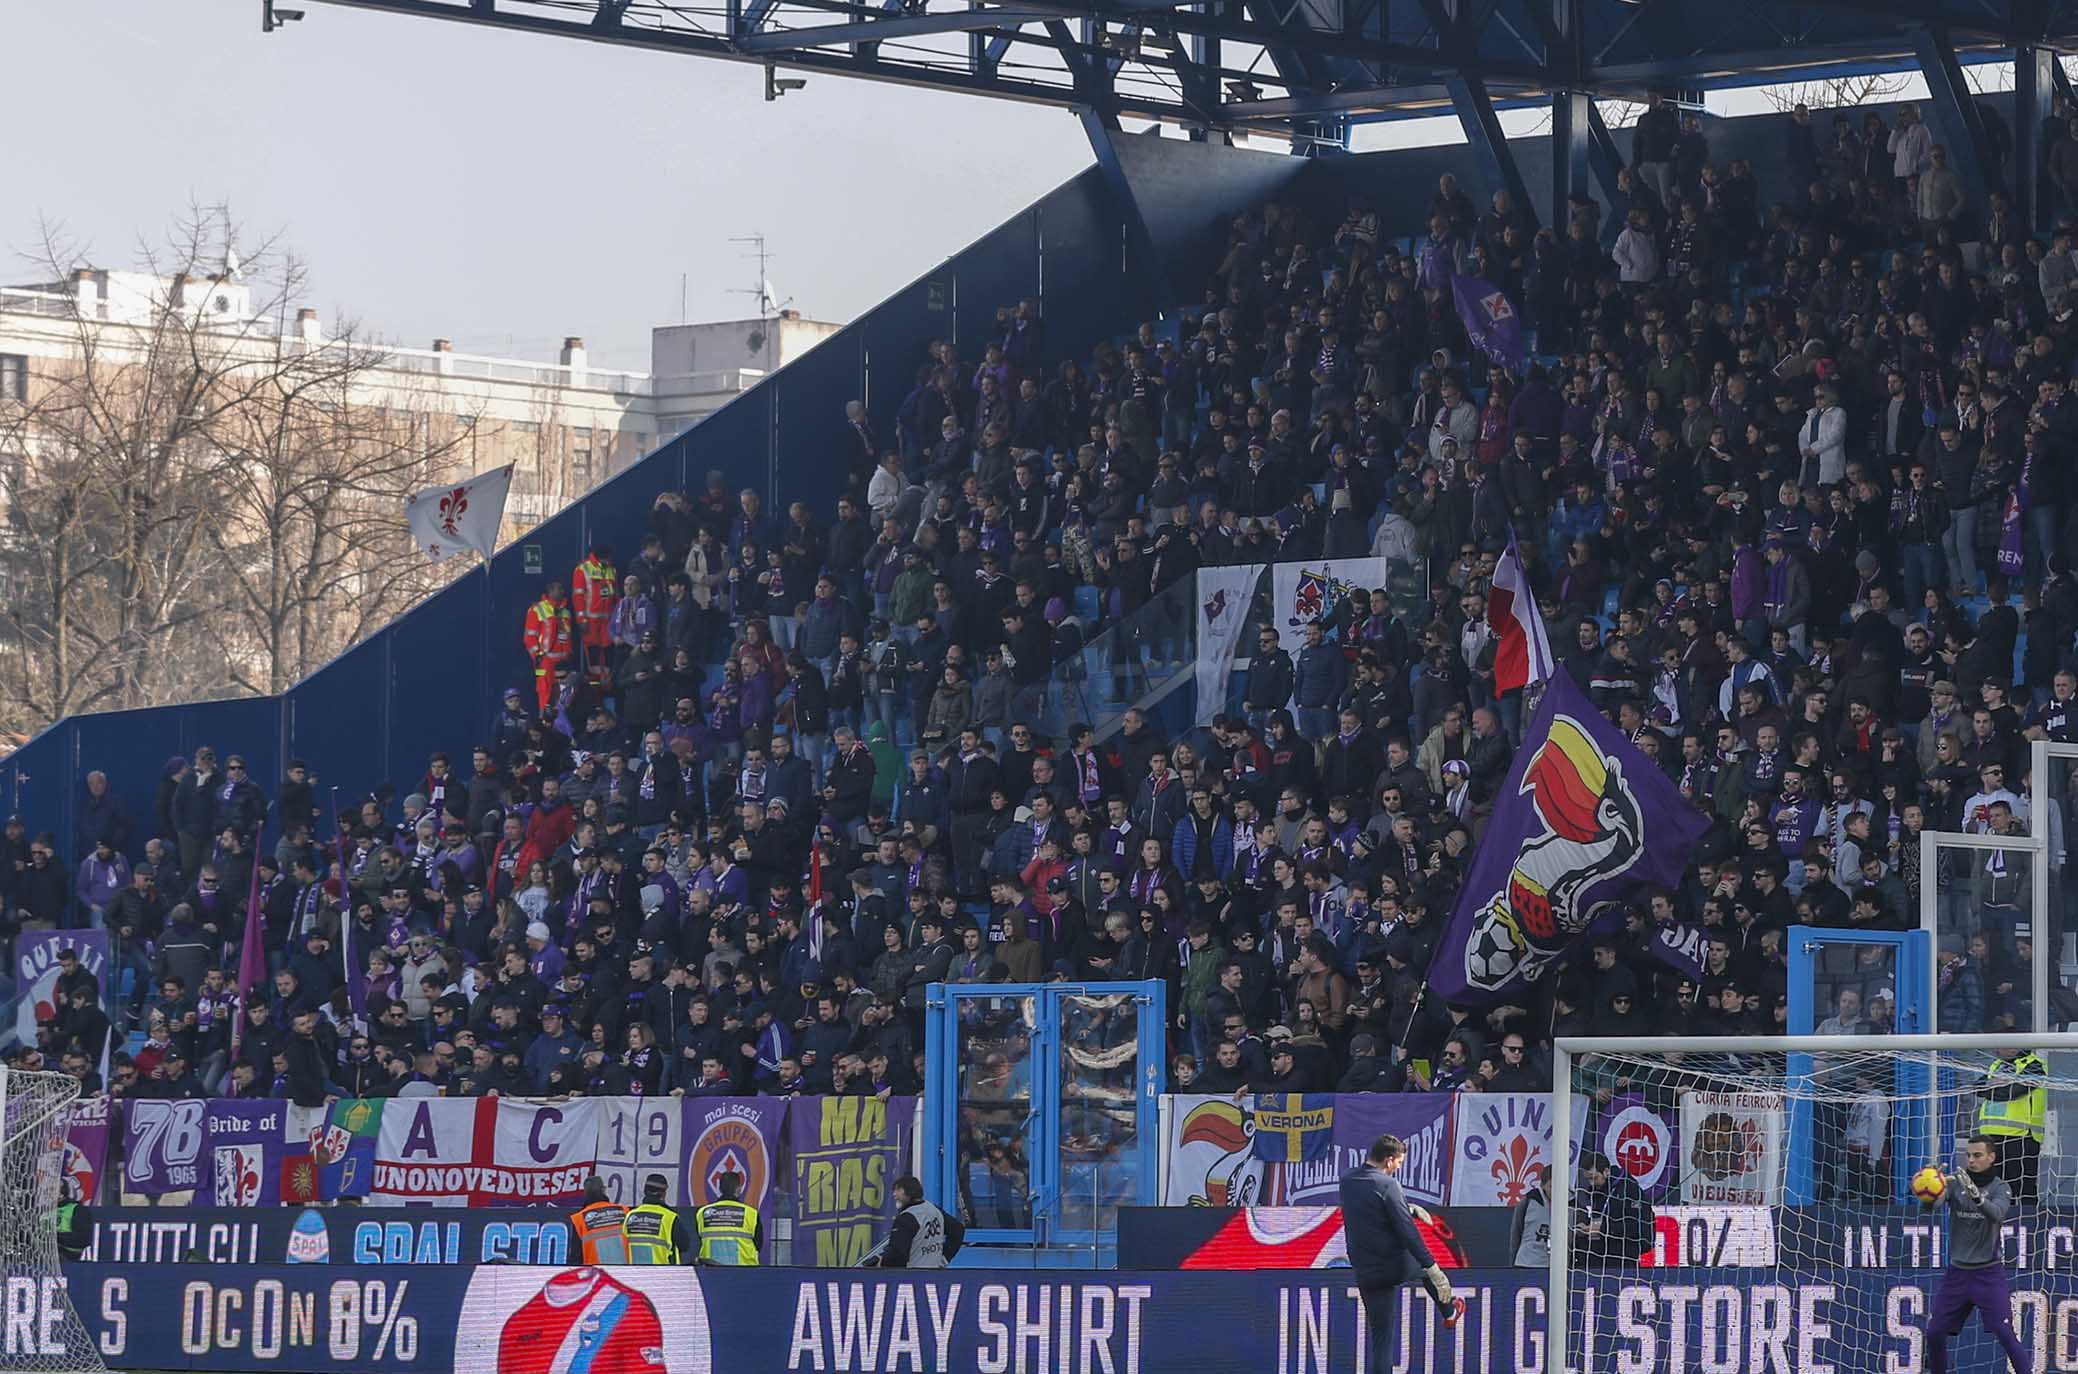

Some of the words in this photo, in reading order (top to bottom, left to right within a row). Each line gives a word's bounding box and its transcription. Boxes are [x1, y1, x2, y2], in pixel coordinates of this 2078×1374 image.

[259, 1113, 278, 1131] of
[704, 1102, 727, 1125] mai
[731, 1103, 763, 1124] scesi
[820, 1096, 887, 1147] MA
[1260, 1112, 1326, 1129] VERONA
[704, 1122, 757, 1153] GRUPPO
[166, 1166, 198, 1185] 1965
[808, 1154, 887, 1214] RAS
[482, 1222, 569, 1264] STO
[1843, 1225, 1887, 1268] IN
[787, 1281, 961, 1373] AWAY
[977, 1284, 1152, 1374] SHIRT
[1278, 1287, 1329, 1374] IN
[1617, 1285, 1836, 1374] STORE
